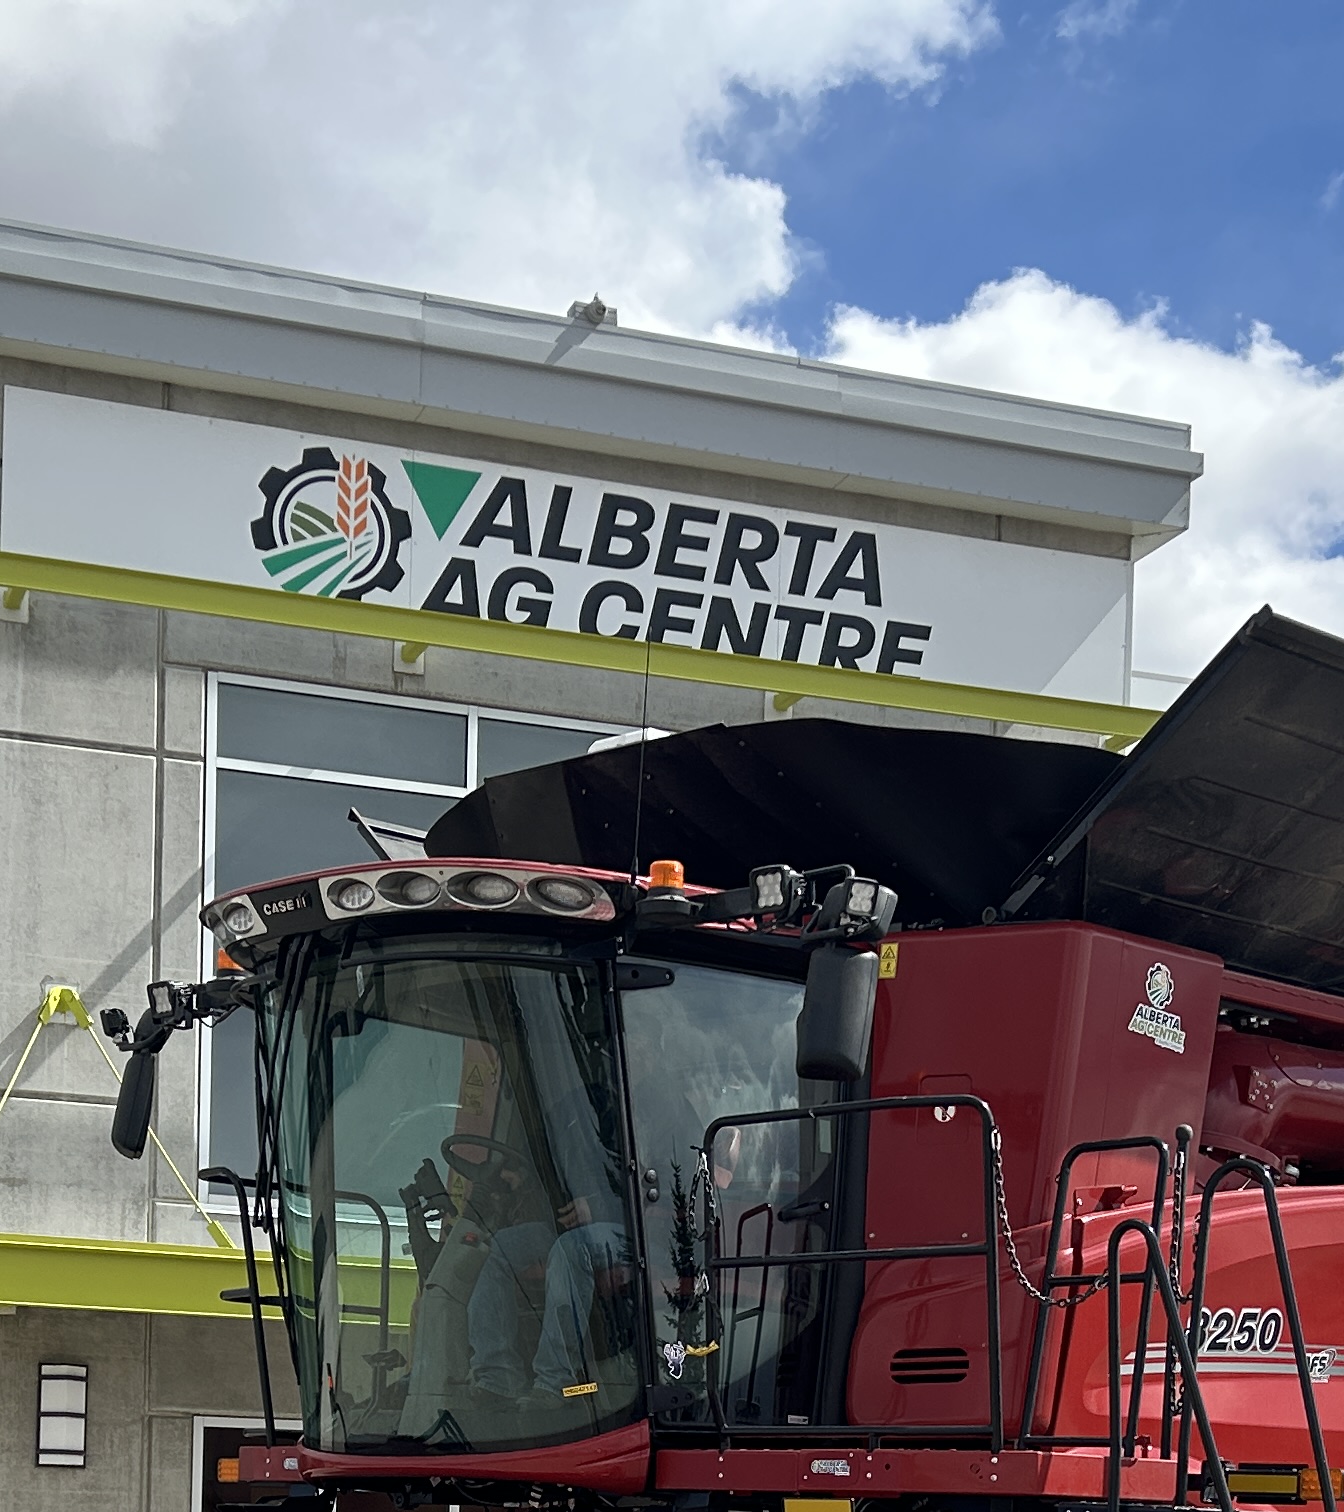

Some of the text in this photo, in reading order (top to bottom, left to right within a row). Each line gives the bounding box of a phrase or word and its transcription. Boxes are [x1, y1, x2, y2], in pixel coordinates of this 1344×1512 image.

[459, 475, 883, 608] ALBERTA
[420, 556, 933, 680] AG CENTRE
[263, 898, 295, 916] CASE
[1130, 1018, 1185, 1045] AG CENTRE
[1136, 1005, 1181, 1031] ALBERTA
